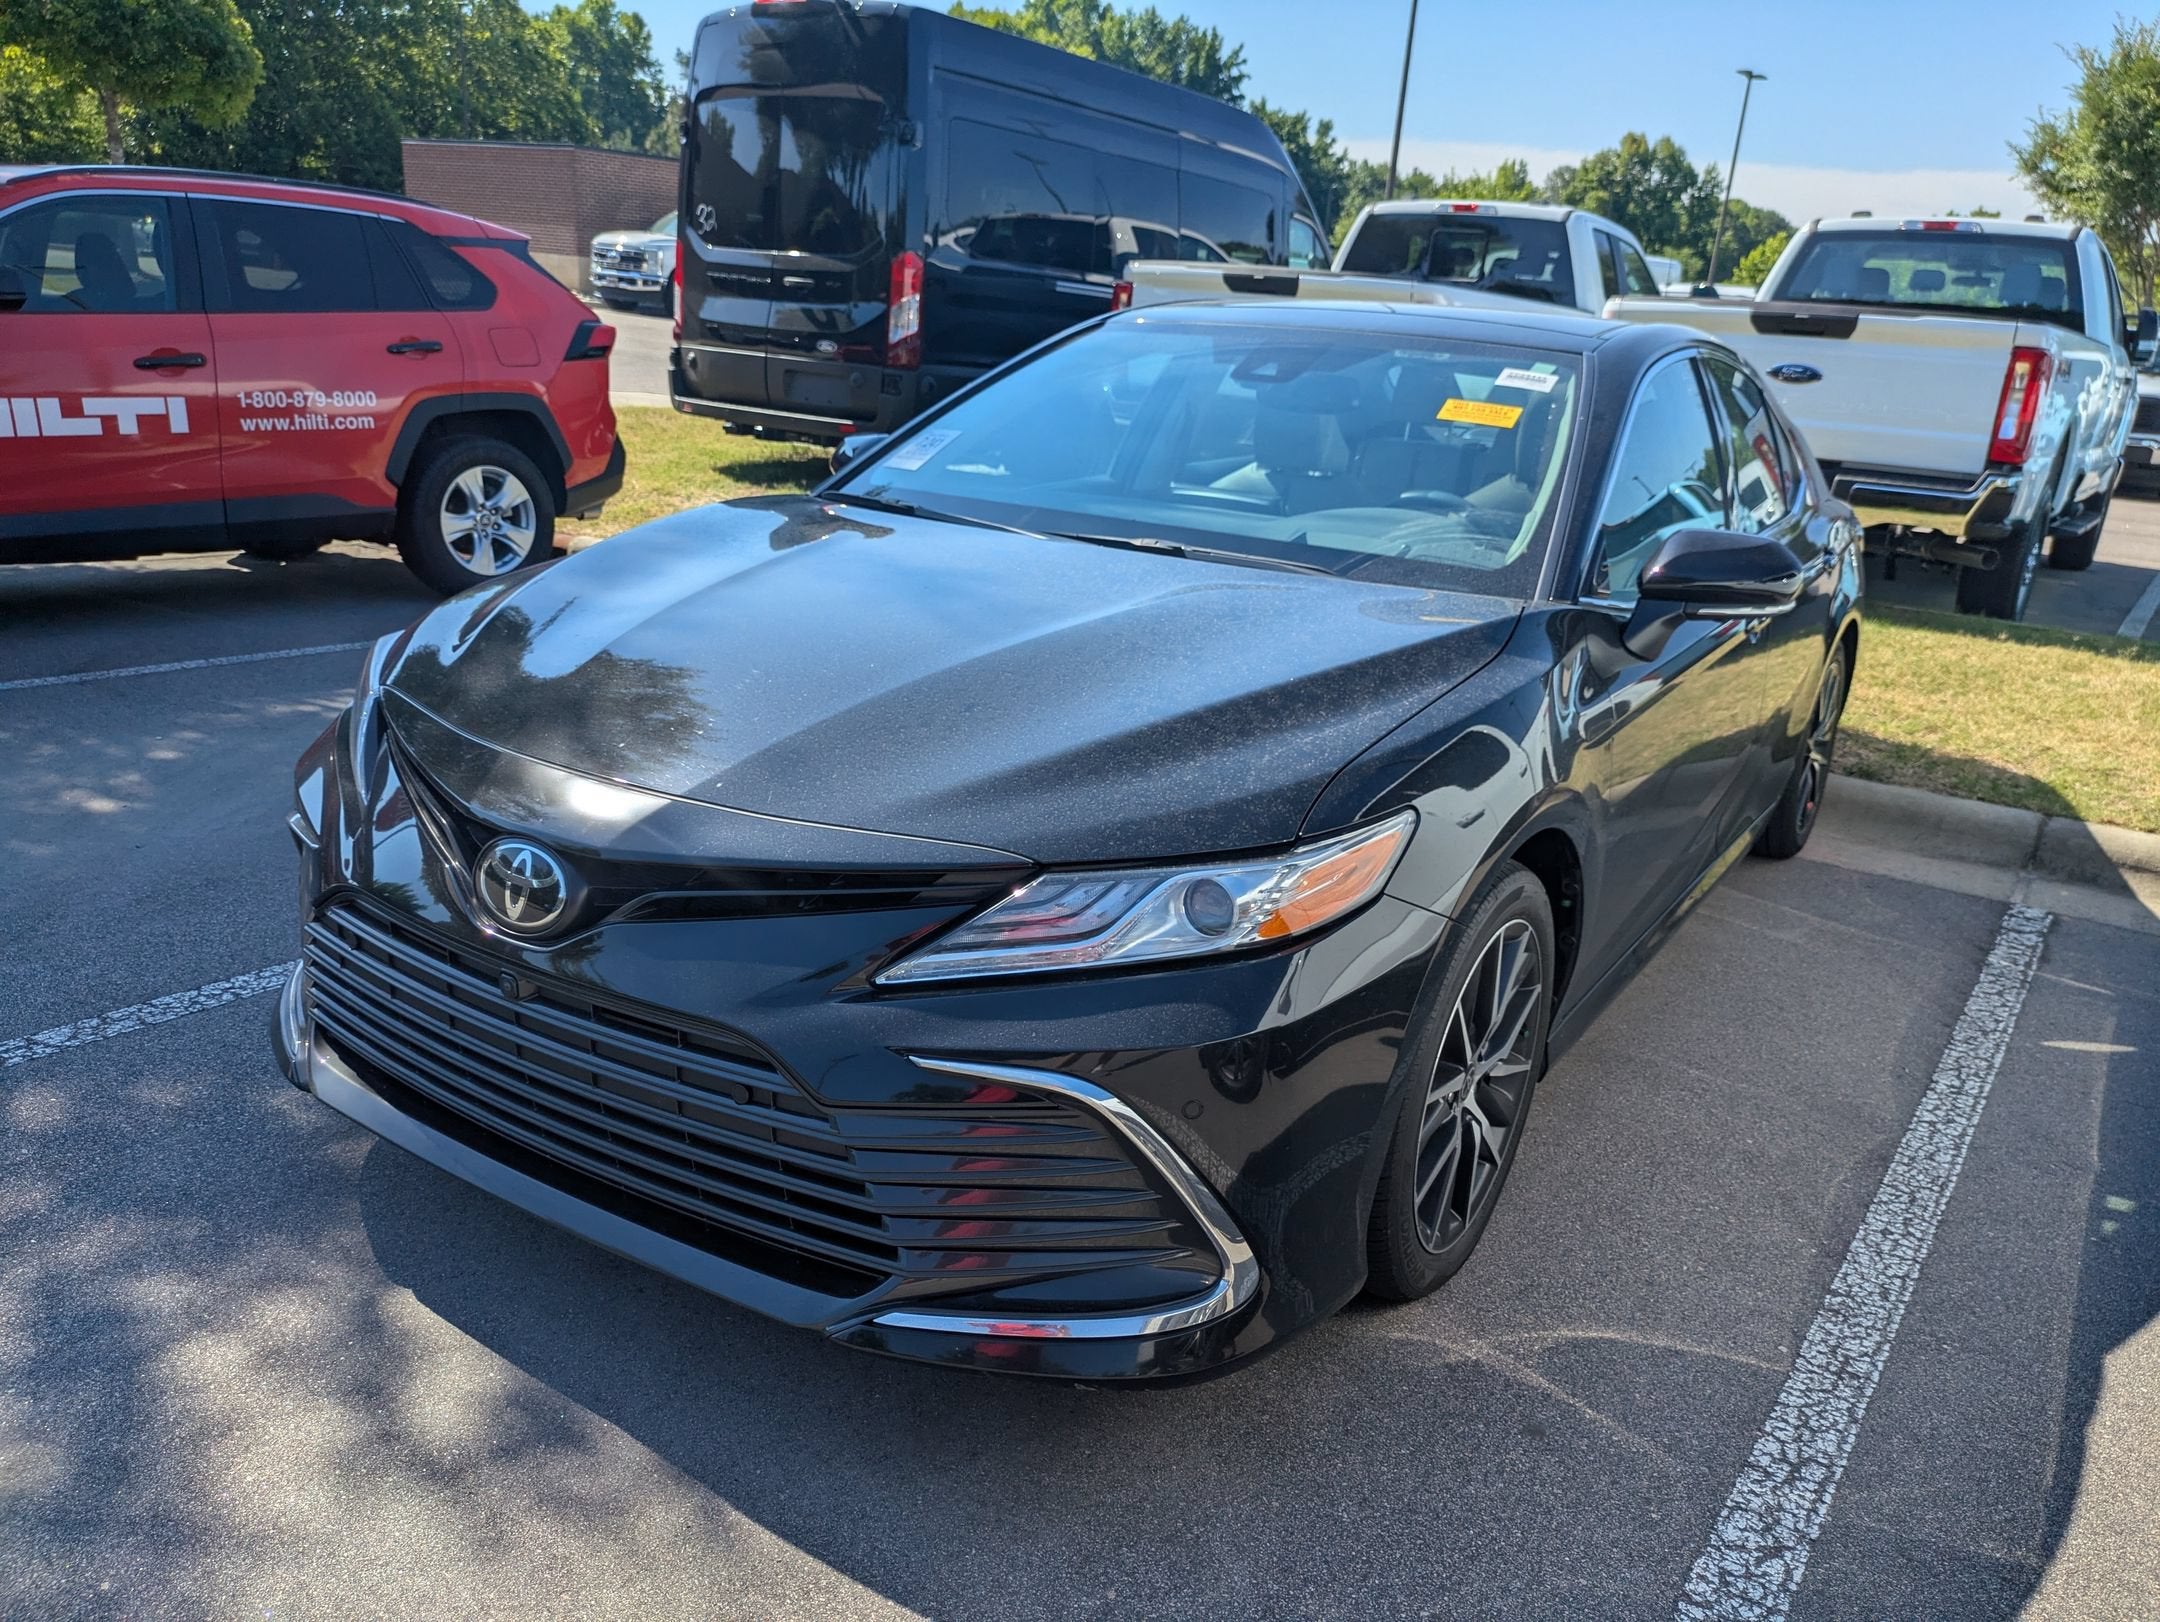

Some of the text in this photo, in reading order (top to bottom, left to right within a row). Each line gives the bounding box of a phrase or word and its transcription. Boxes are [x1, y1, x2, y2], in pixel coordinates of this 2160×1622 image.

[236, 390, 377, 408] 1-800-879-8000
[0, 396, 190, 438] ILTI
[240, 414, 375, 431] www.hilti.com
